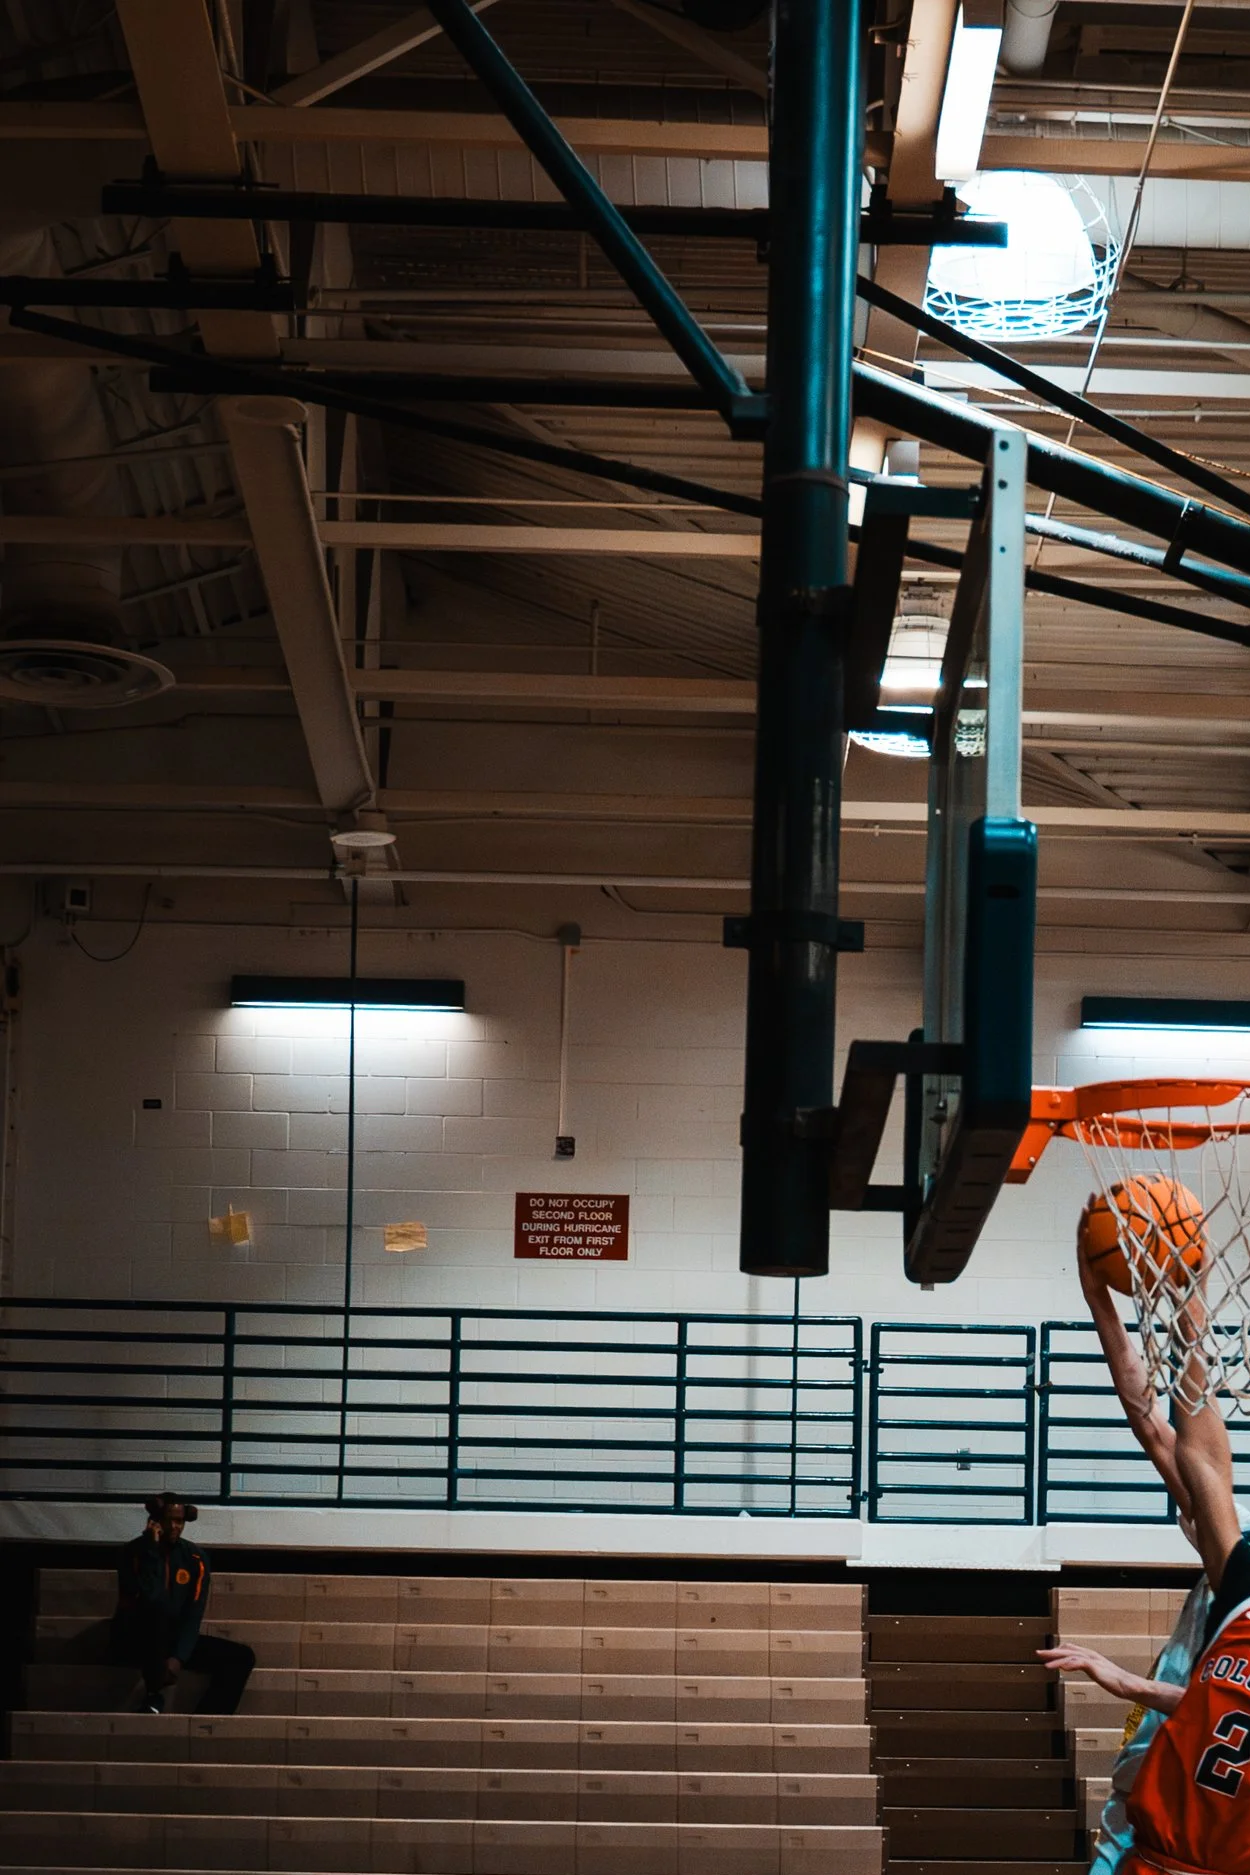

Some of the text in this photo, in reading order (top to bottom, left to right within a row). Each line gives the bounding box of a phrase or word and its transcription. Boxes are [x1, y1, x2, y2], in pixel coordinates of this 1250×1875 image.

[529, 1198, 615, 1209] DO NOT OCCUPY
[531, 1210, 613, 1221] SECOND FLOOR
[521, 1222, 622, 1234] DURING HURRICANE
[527, 1235, 615, 1246] EXIT FROM FIRST
[539, 1246, 603, 1257] FLOOR ONLY
